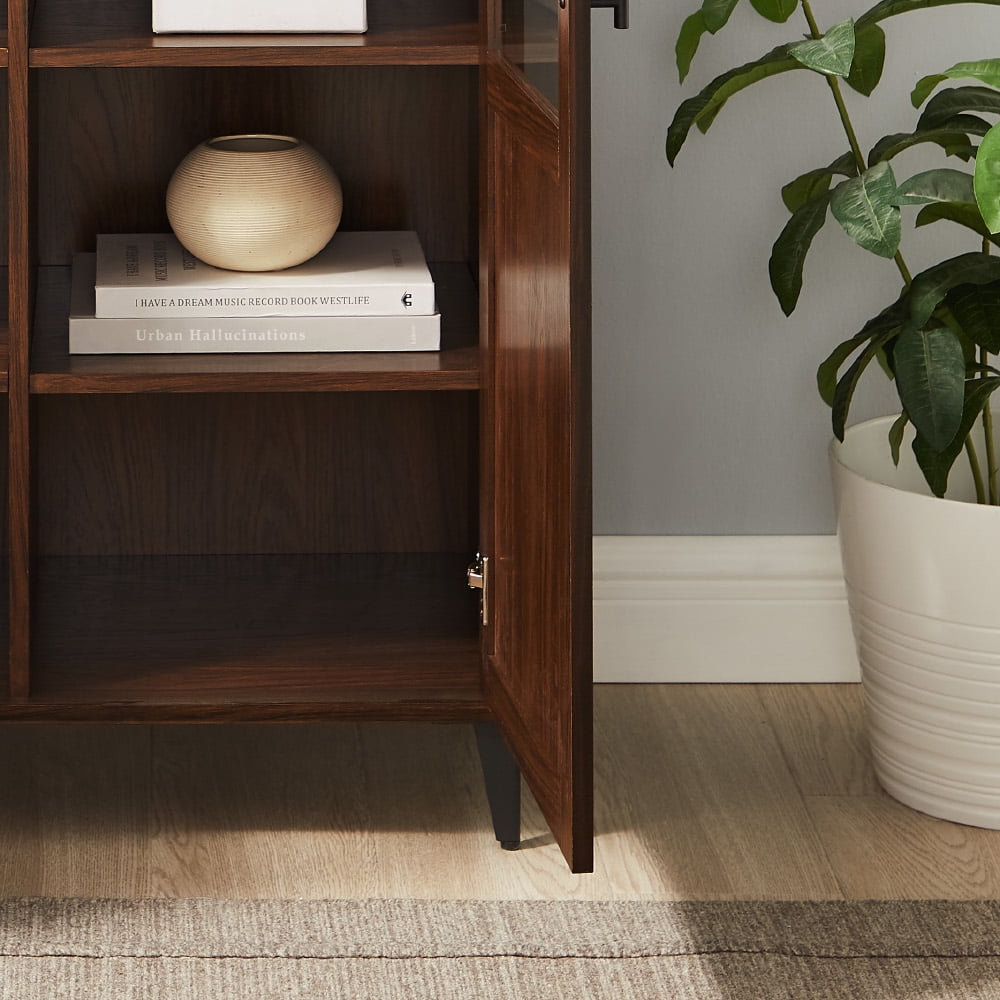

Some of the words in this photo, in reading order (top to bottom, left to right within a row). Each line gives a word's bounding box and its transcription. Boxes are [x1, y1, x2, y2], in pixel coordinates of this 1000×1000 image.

[141, 299, 167, 307] HAVE
[168, 298, 176, 307] A
[177, 298, 213, 307] DREAM
[215, 298, 246, 306] MUSIC
[248, 297, 288, 306] RECORD
[290, 297, 318, 305] BOOK
[320, 296, 370, 305] WESTLIFE
[136, 328, 183, 341] Urban
[189, 328, 306, 341] Hallucinations
